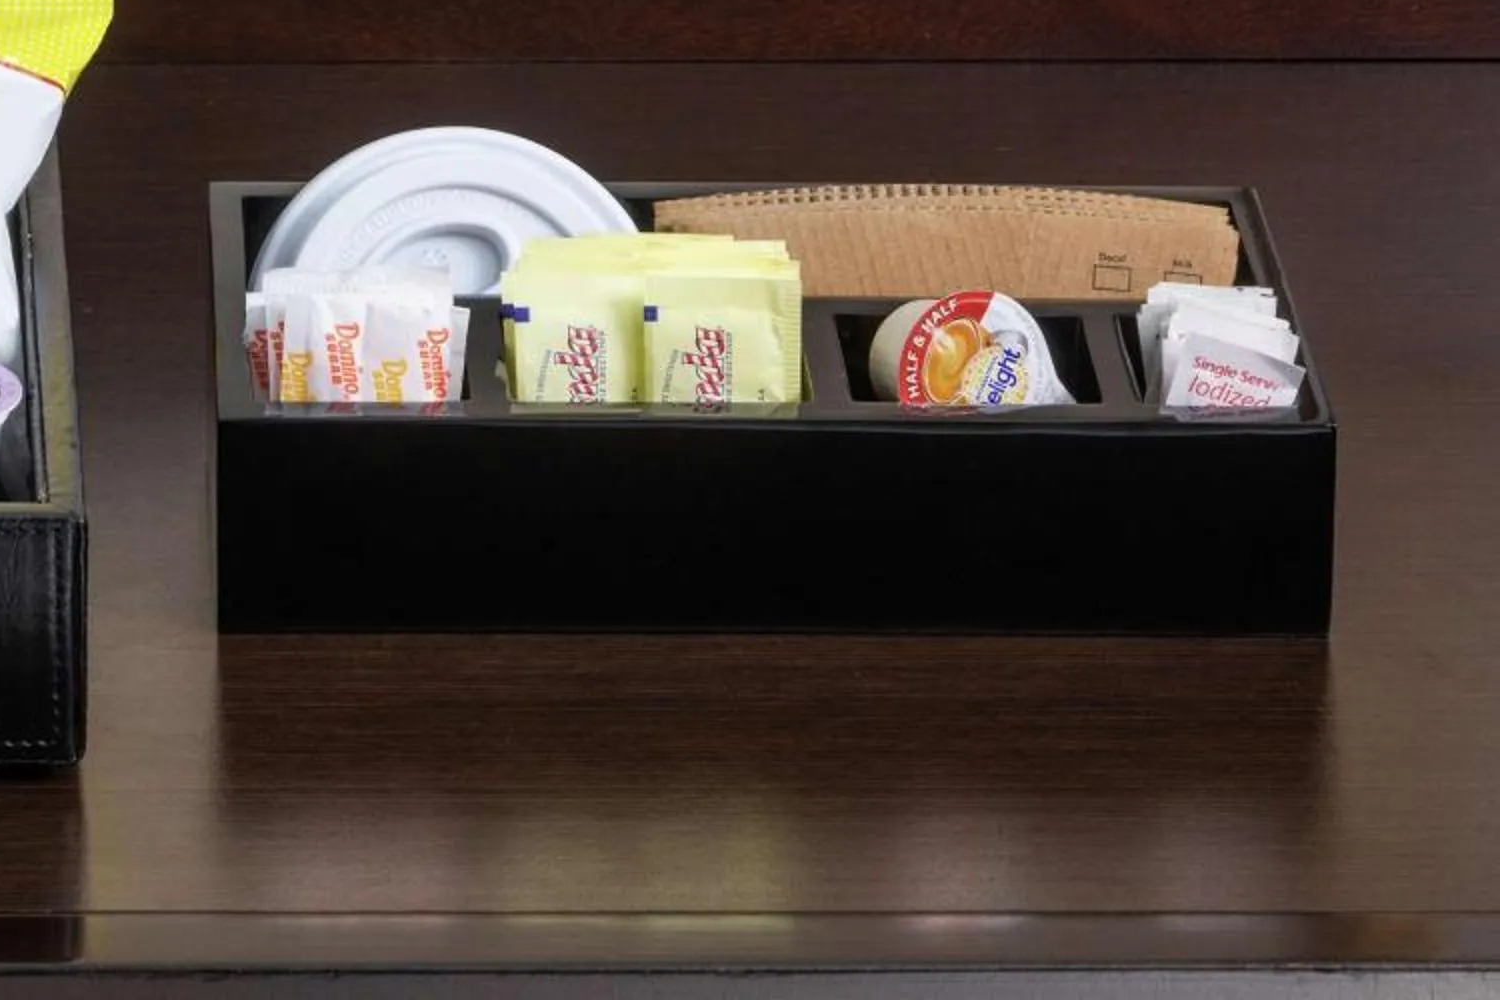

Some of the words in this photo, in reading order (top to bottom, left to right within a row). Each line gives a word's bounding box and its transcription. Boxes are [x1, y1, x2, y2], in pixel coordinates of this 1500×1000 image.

[334, 322, 362, 396] Domino
[426, 327, 451, 399] Domino
[906, 352, 920, 398] HALF
[920, 297, 959, 334] HALF
[1192, 355, 1238, 380] Single
[287, 351, 314, 403] Dom
[381, 358, 408, 403] Dom
[984, 348, 1021, 406] elight
